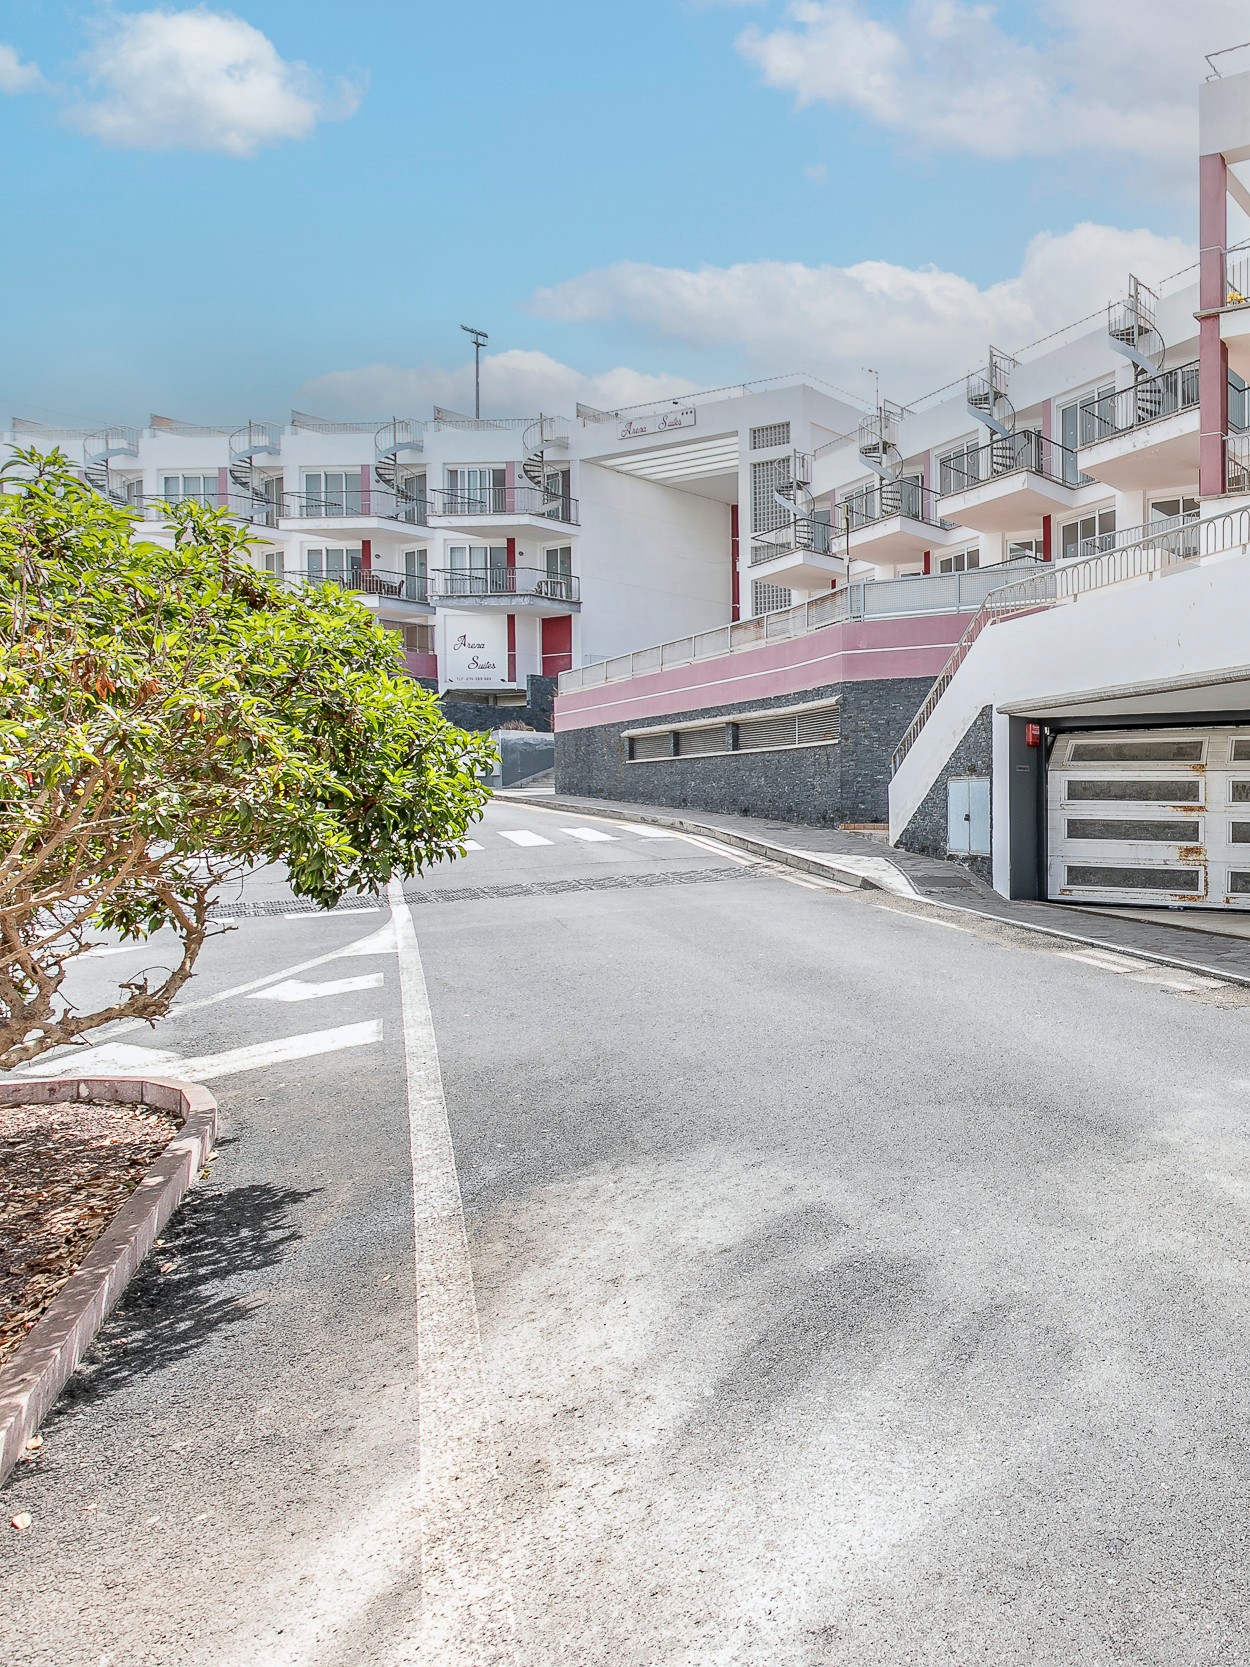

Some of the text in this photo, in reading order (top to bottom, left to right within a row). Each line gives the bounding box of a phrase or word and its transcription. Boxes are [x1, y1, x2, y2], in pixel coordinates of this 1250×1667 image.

[621, 415, 682, 437] Arena Suites
[453, 634, 485, 651] Arena
[467, 655, 496, 670] Suites
